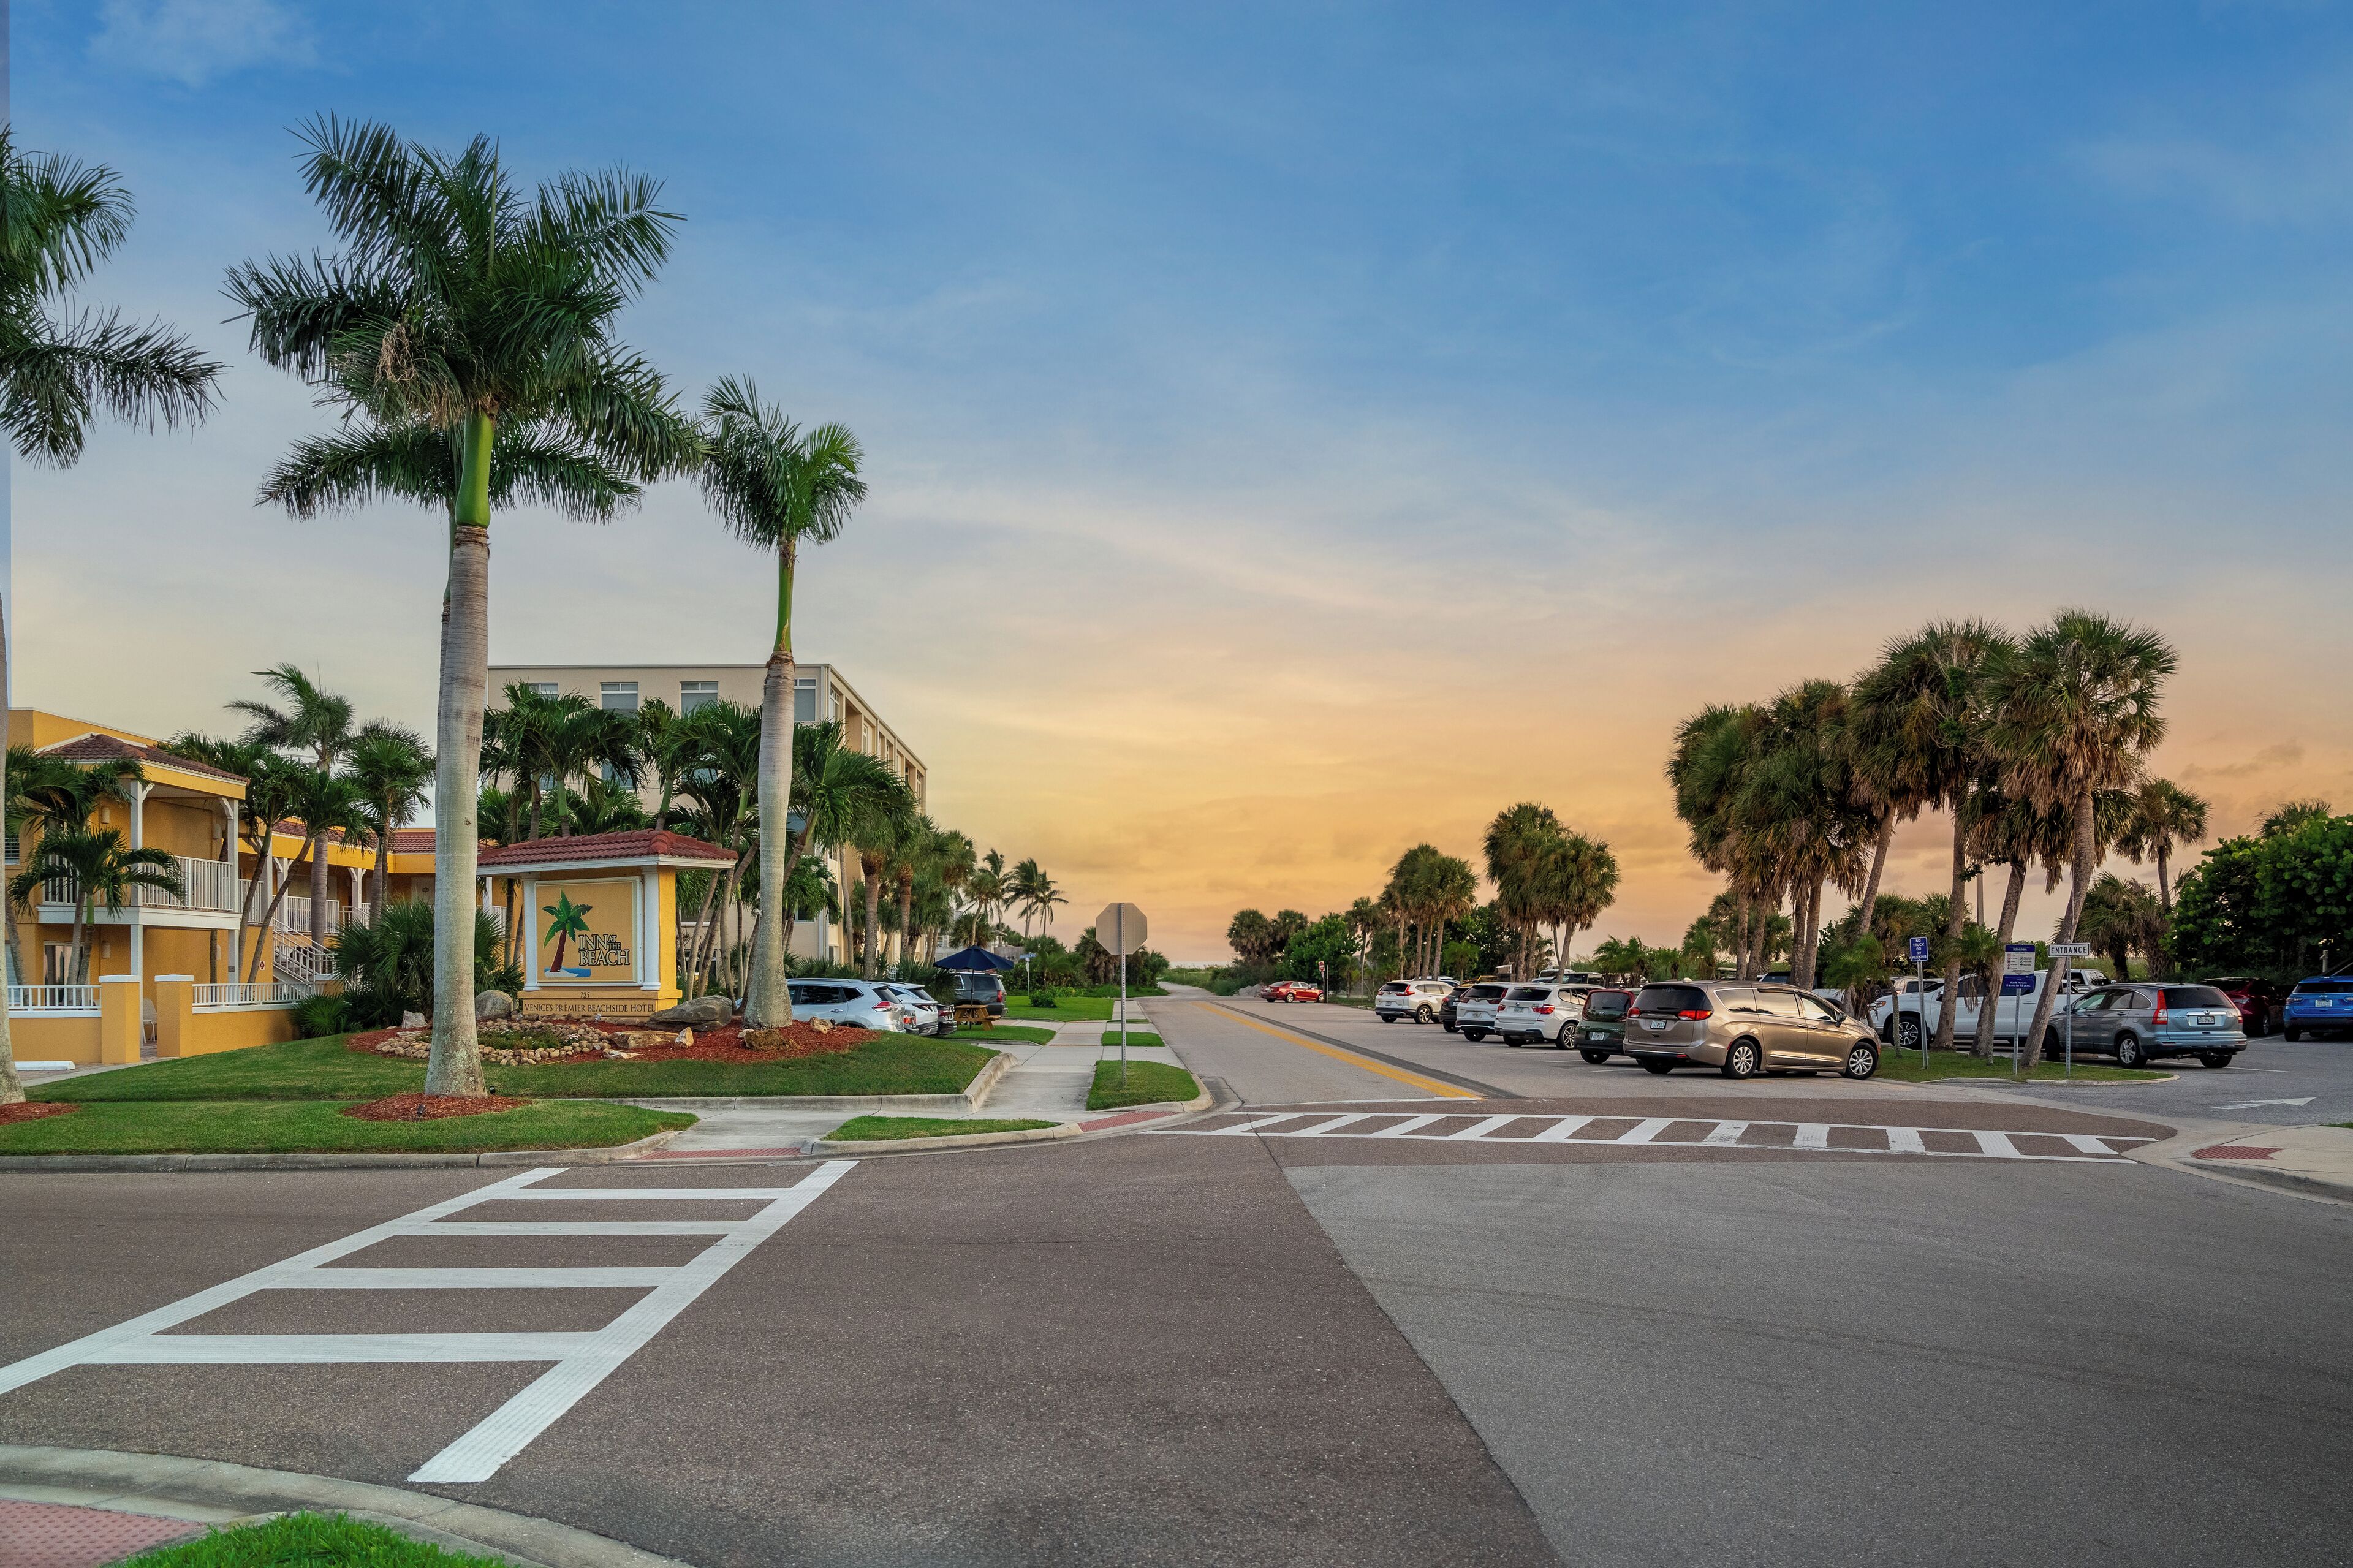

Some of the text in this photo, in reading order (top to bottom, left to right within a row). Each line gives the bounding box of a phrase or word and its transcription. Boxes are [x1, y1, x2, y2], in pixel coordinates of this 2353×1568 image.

[578, 934, 617, 950] INN AT
[608, 942, 621, 950] THE
[578, 949, 631, 966] BEACH
[631, 1004, 656, 1012] HOTEL
